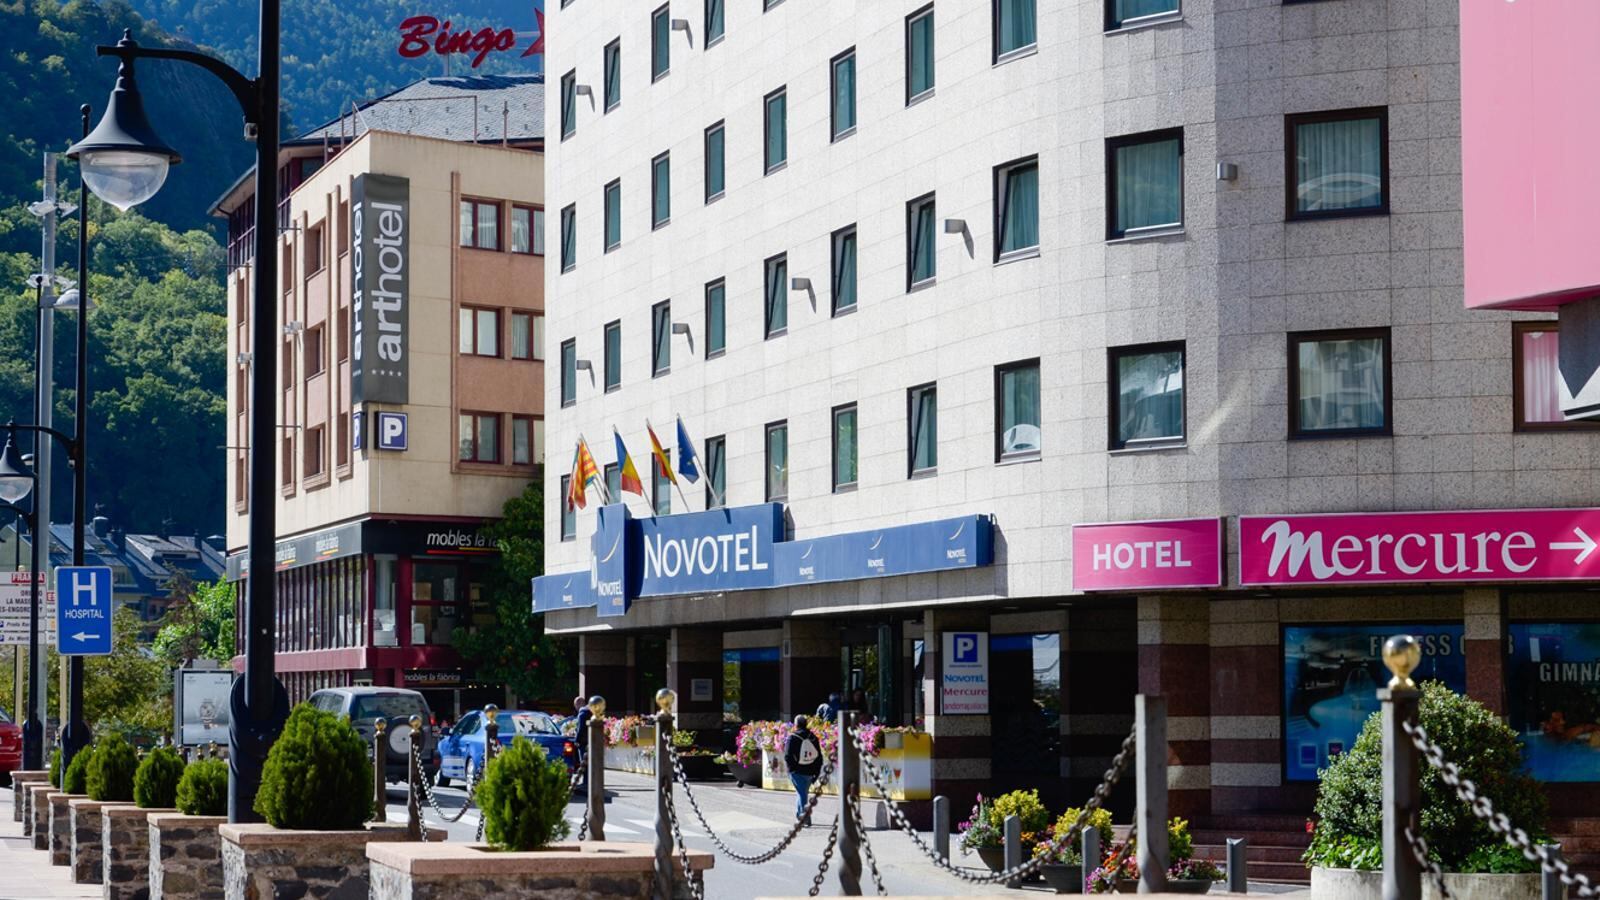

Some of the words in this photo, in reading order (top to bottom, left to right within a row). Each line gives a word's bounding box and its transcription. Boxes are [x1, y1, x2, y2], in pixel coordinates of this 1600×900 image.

[398, 15, 515, 69] Bingo
[353, 202, 364, 361] arthotel
[371, 202, 403, 362] arthotel
[384, 417, 403, 445] P
[426, 529, 472, 546] mobles
[1261, 520, 1538, 580] Mercure
[1092, 541, 1193, 571] HOTEL
[72, 572, 97, 606] H
[64, 609, 105, 619] HOSPITAL
[956, 637, 975, 659] P
[944, 688, 988, 696] Mercure
